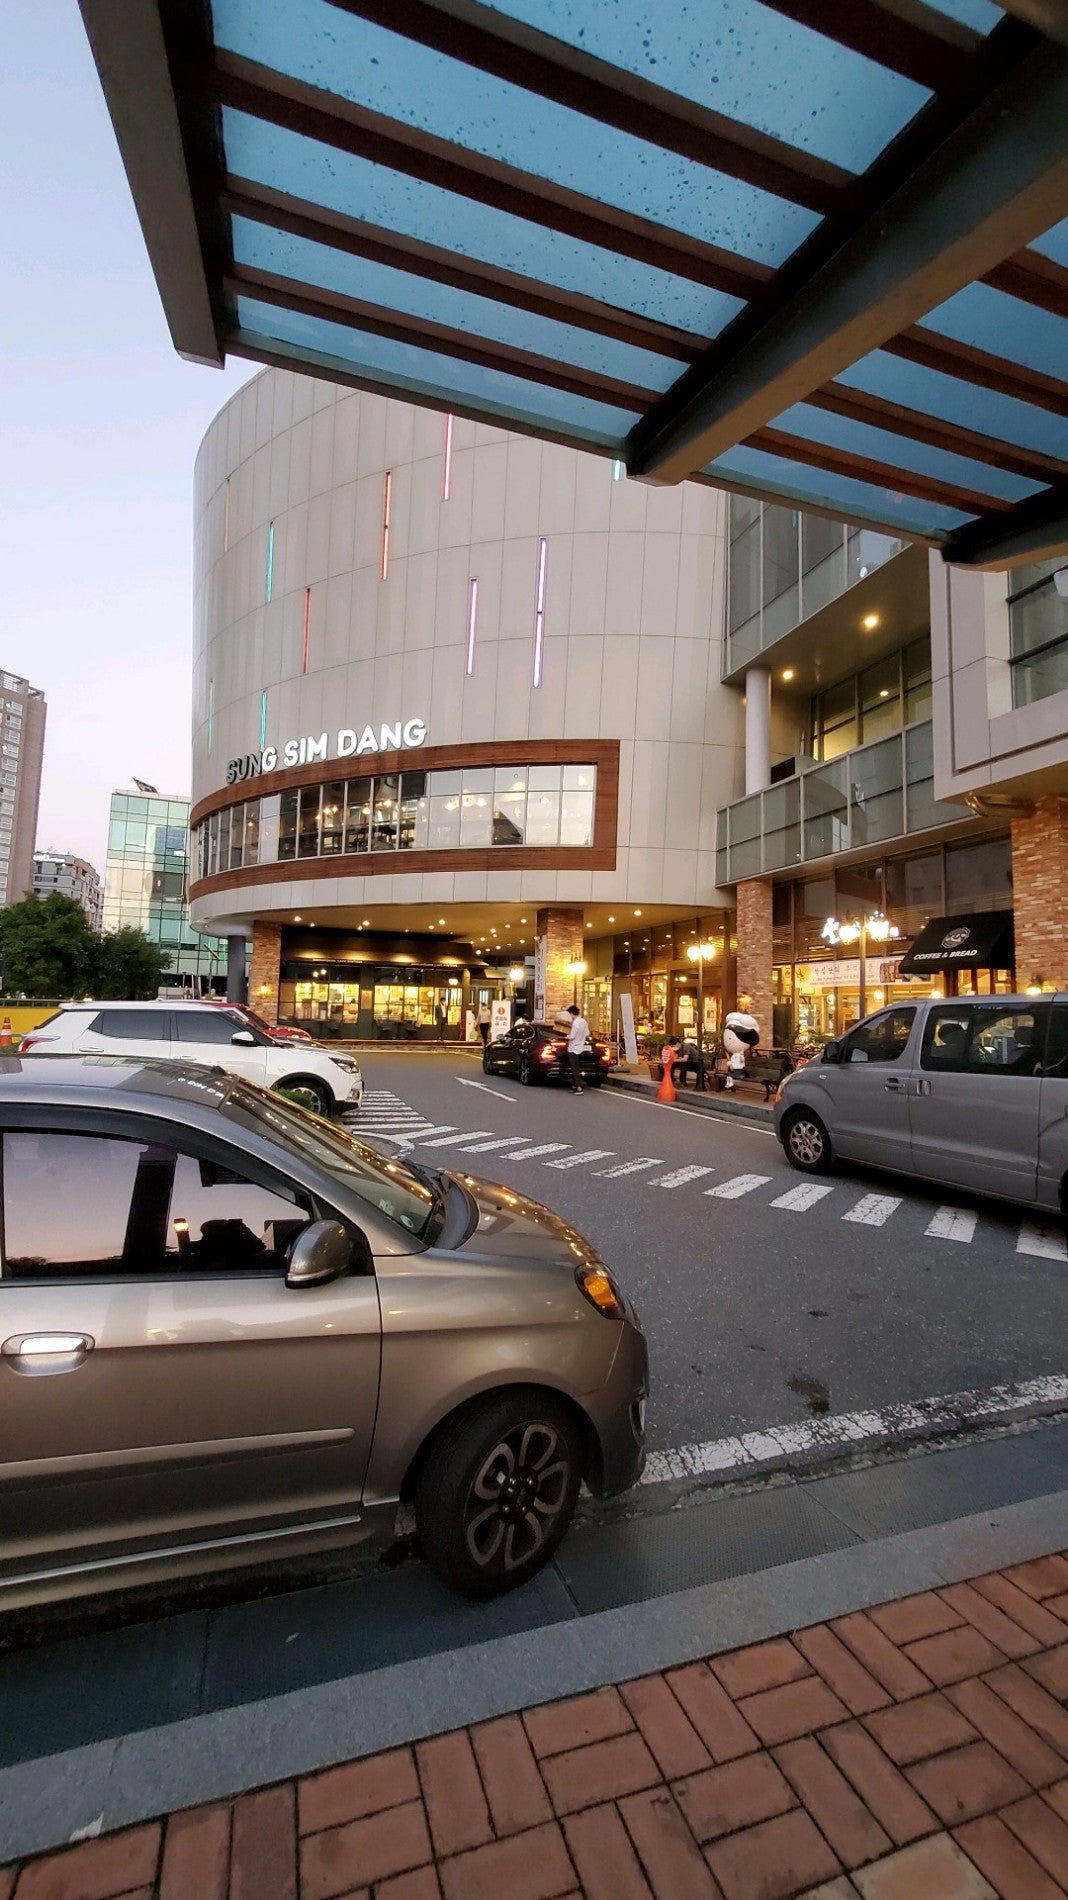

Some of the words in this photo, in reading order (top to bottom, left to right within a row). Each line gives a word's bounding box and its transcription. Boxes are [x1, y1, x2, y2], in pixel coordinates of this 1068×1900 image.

[225, 745, 278, 785] SUNG
[283, 732, 327, 767] SIM
[336, 717, 427, 757] DANG
[913, 952, 943, 960] COFFEE
[941, 951, 949, 959] &
[948, 949, 978, 958] BREAD
